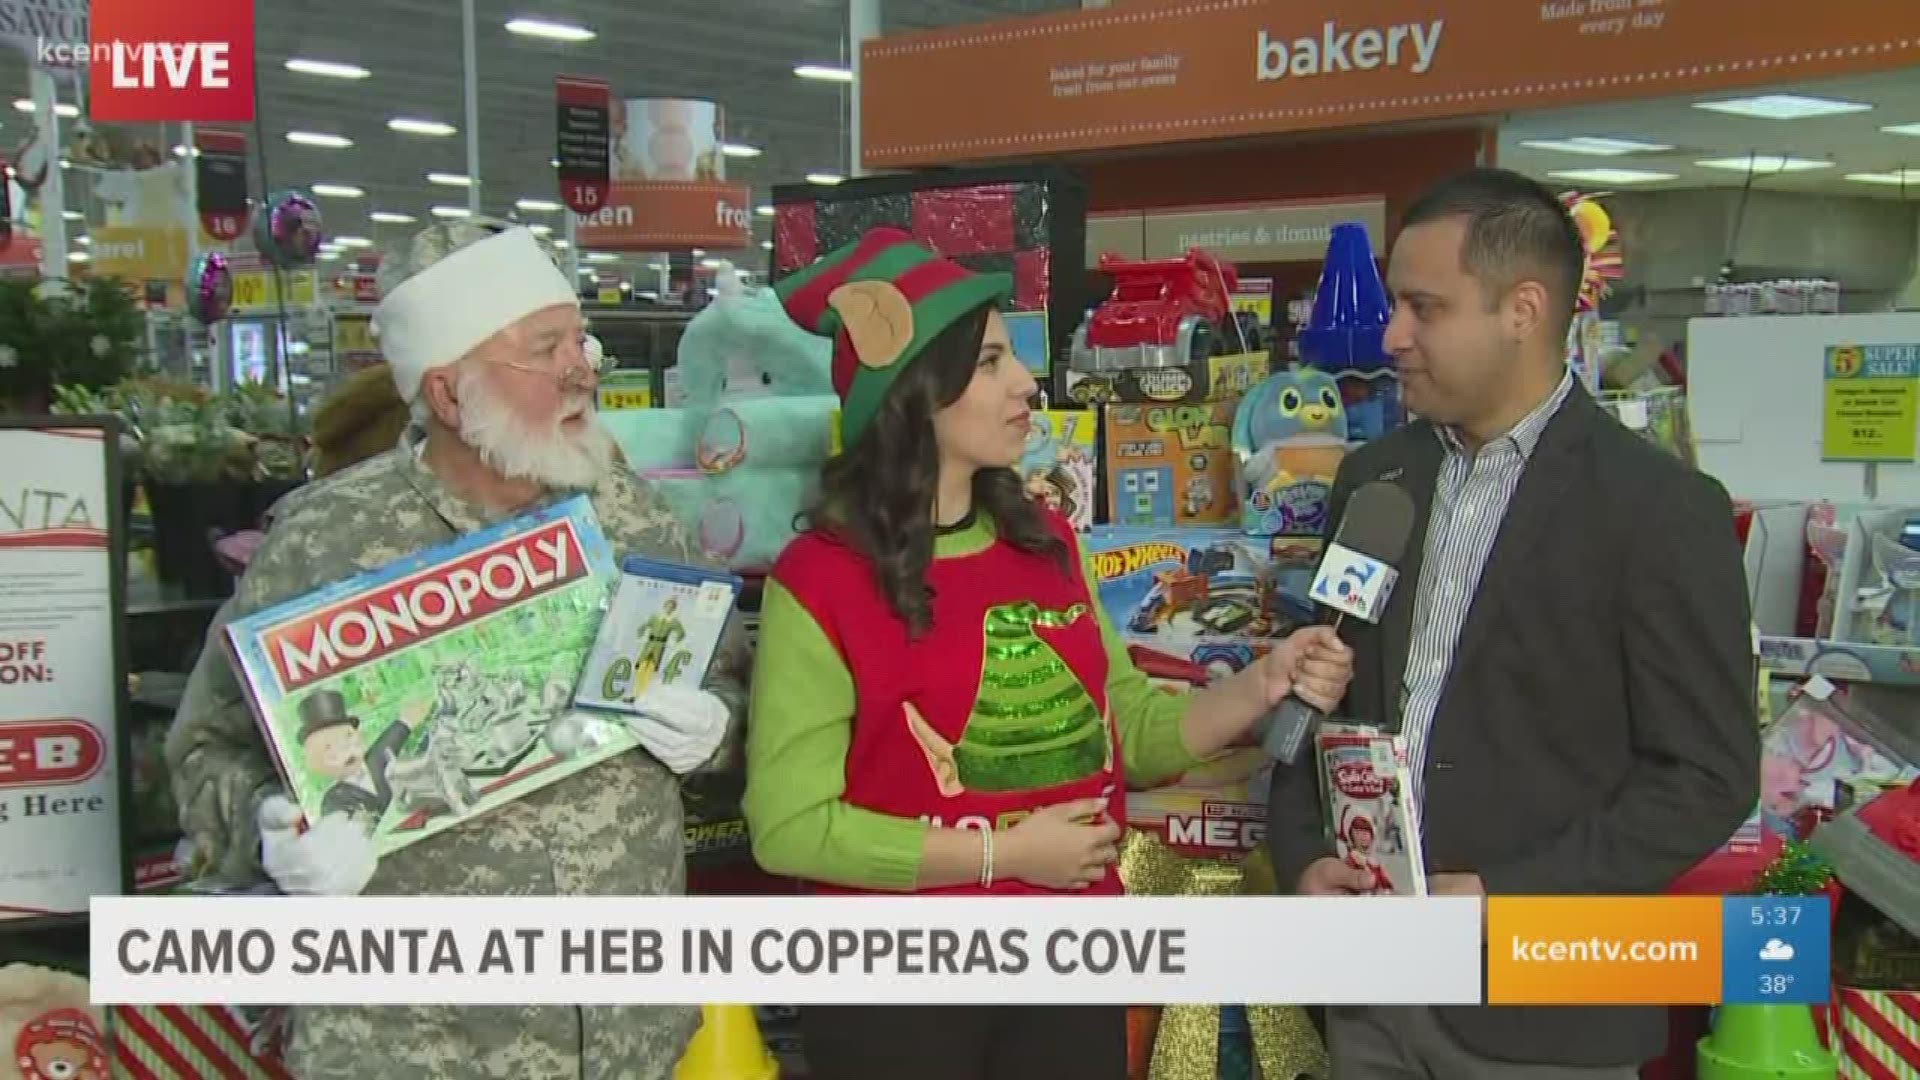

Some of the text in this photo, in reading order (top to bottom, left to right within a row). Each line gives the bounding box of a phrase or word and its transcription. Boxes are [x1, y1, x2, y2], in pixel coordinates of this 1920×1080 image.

[1579, 11, 1664, 34] every day
[1257, 20, 1443, 81] bakery
[574, 186, 597, 205] 15
[213, 216, 236, 232] 16
[1180, 231, 1249, 252] pastries
[1254, 229, 1270, 243] &
[1835, 346, 1916, 375] 5 SUPER
[1145, 370, 1188, 384] DUMP
[277, 530, 568, 682] MONOPOLY
[23, 795, 104, 816] Here
